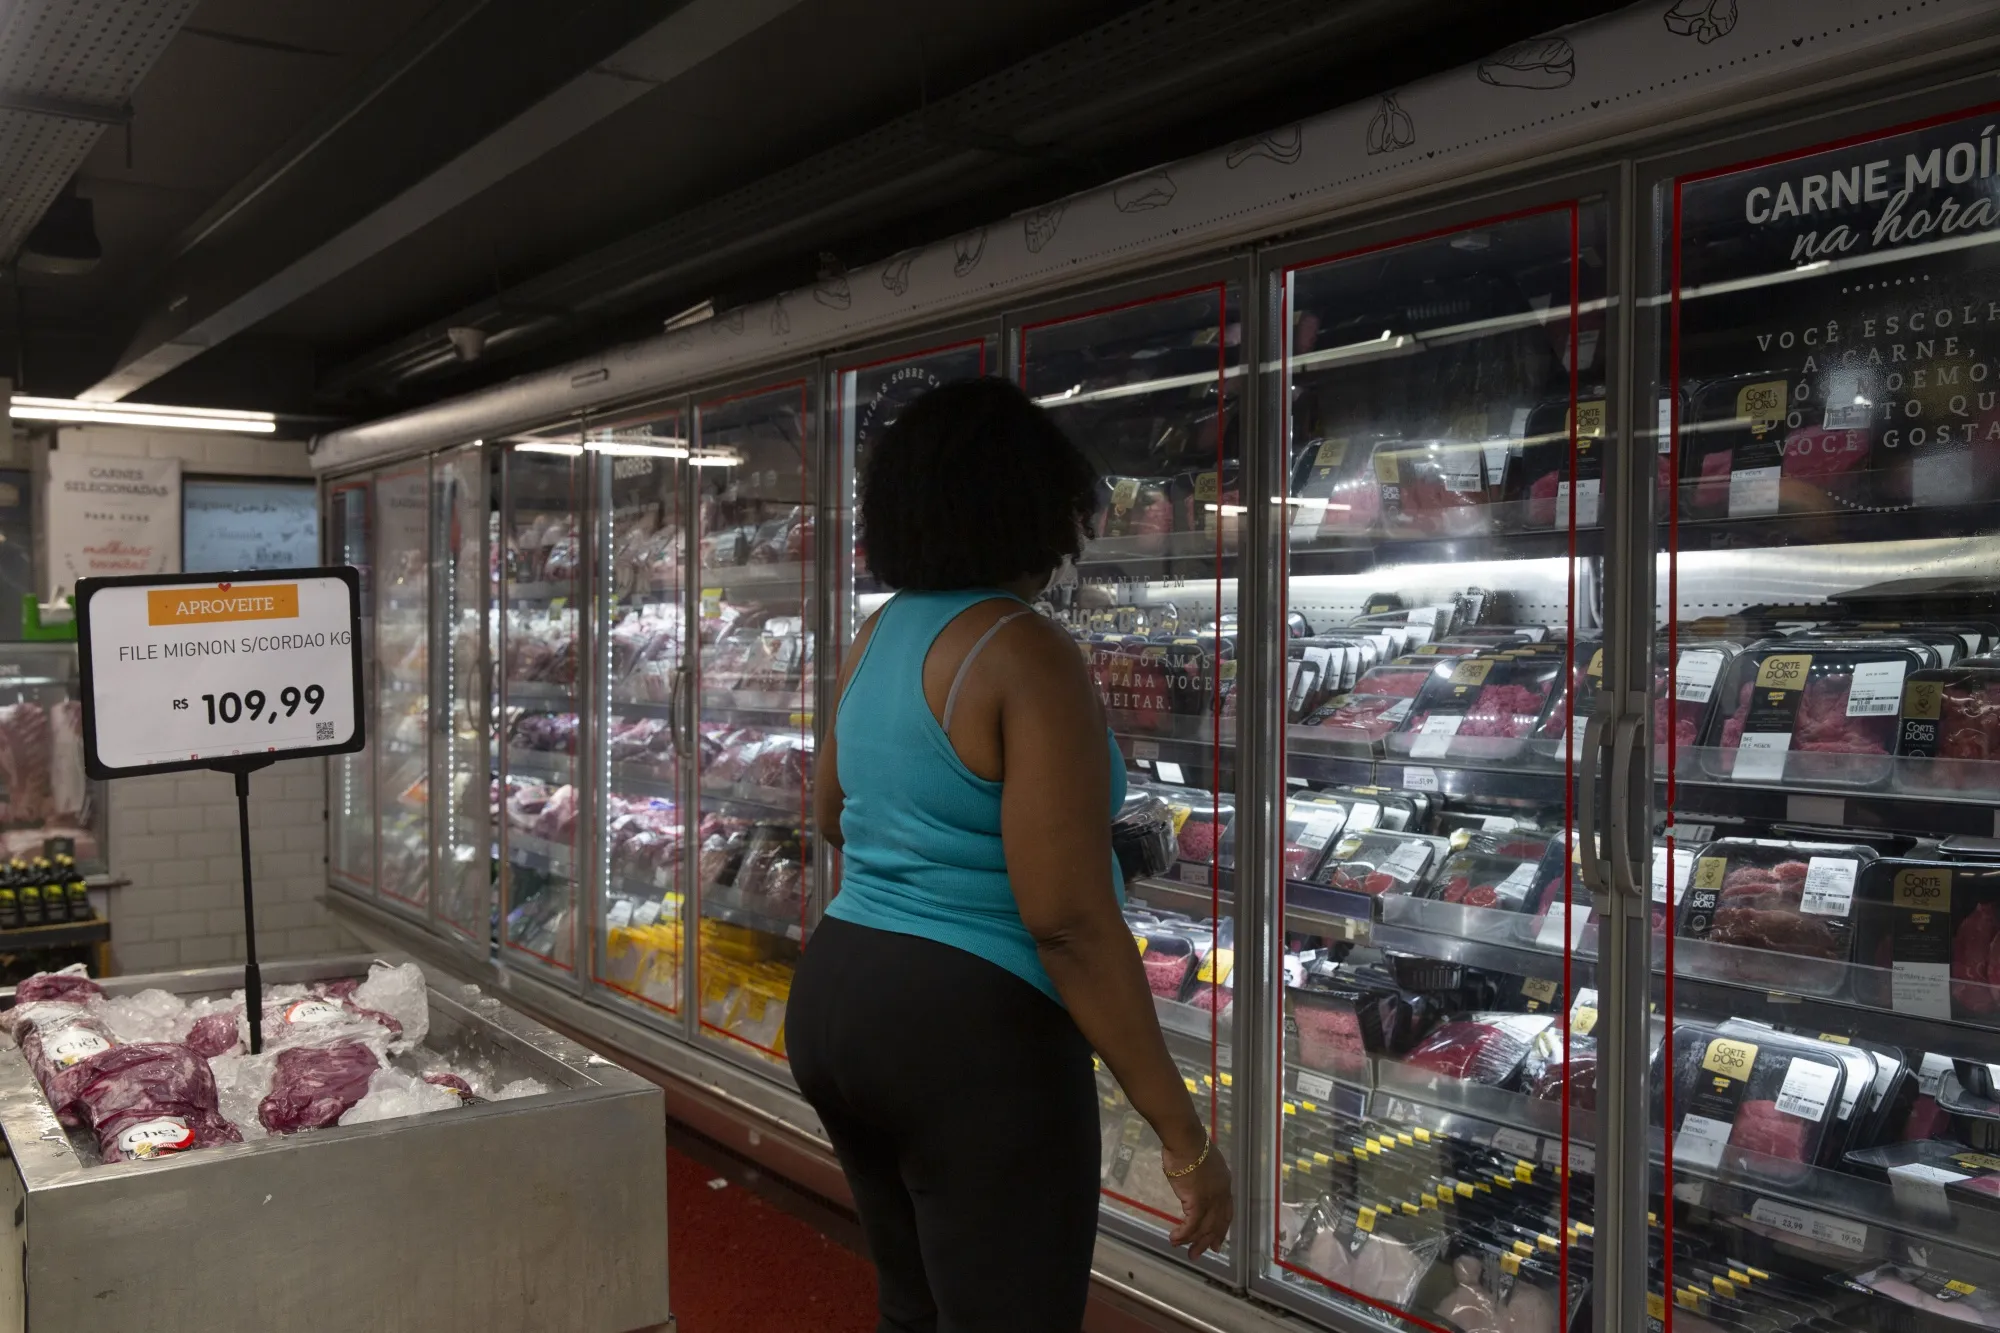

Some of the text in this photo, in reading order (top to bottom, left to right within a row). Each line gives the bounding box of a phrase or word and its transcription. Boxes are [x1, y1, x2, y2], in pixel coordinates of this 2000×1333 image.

[1746, 124, 2000, 224] CARNE MOÍ
[1790, 188, 2000, 260] na hora
[1757, 320, 1839, 351] VOCÊ
[1802, 337, 1975, 374] A CARNE,
[892, 368, 924, 384] SOBRE
[1774, 421, 2000, 456] VOCÊ GOSTA
[63, 480, 169, 497] SELECIONADAS
[175, 596, 275, 616] APROVEITE
[119, 631, 352, 661] FILE MIGNON S/CORDAO KG
[1769, 659, 1800, 671] CORTE
[1112, 674, 1155, 688] PARA
[173, 683, 326, 726] R$ 109,99
[1101, 691, 1171, 710] VEITAR.
[1906, 721, 1935, 733] CORTE
[1904, 873, 1941, 887] CORTE
[1695, 891, 1716, 902] CORTE
[1717, 1042, 1747, 1058] CORTE
[1782, 1219, 1803, 1231] 23,99
[1841, 1234, 1862, 1246] 19,99
